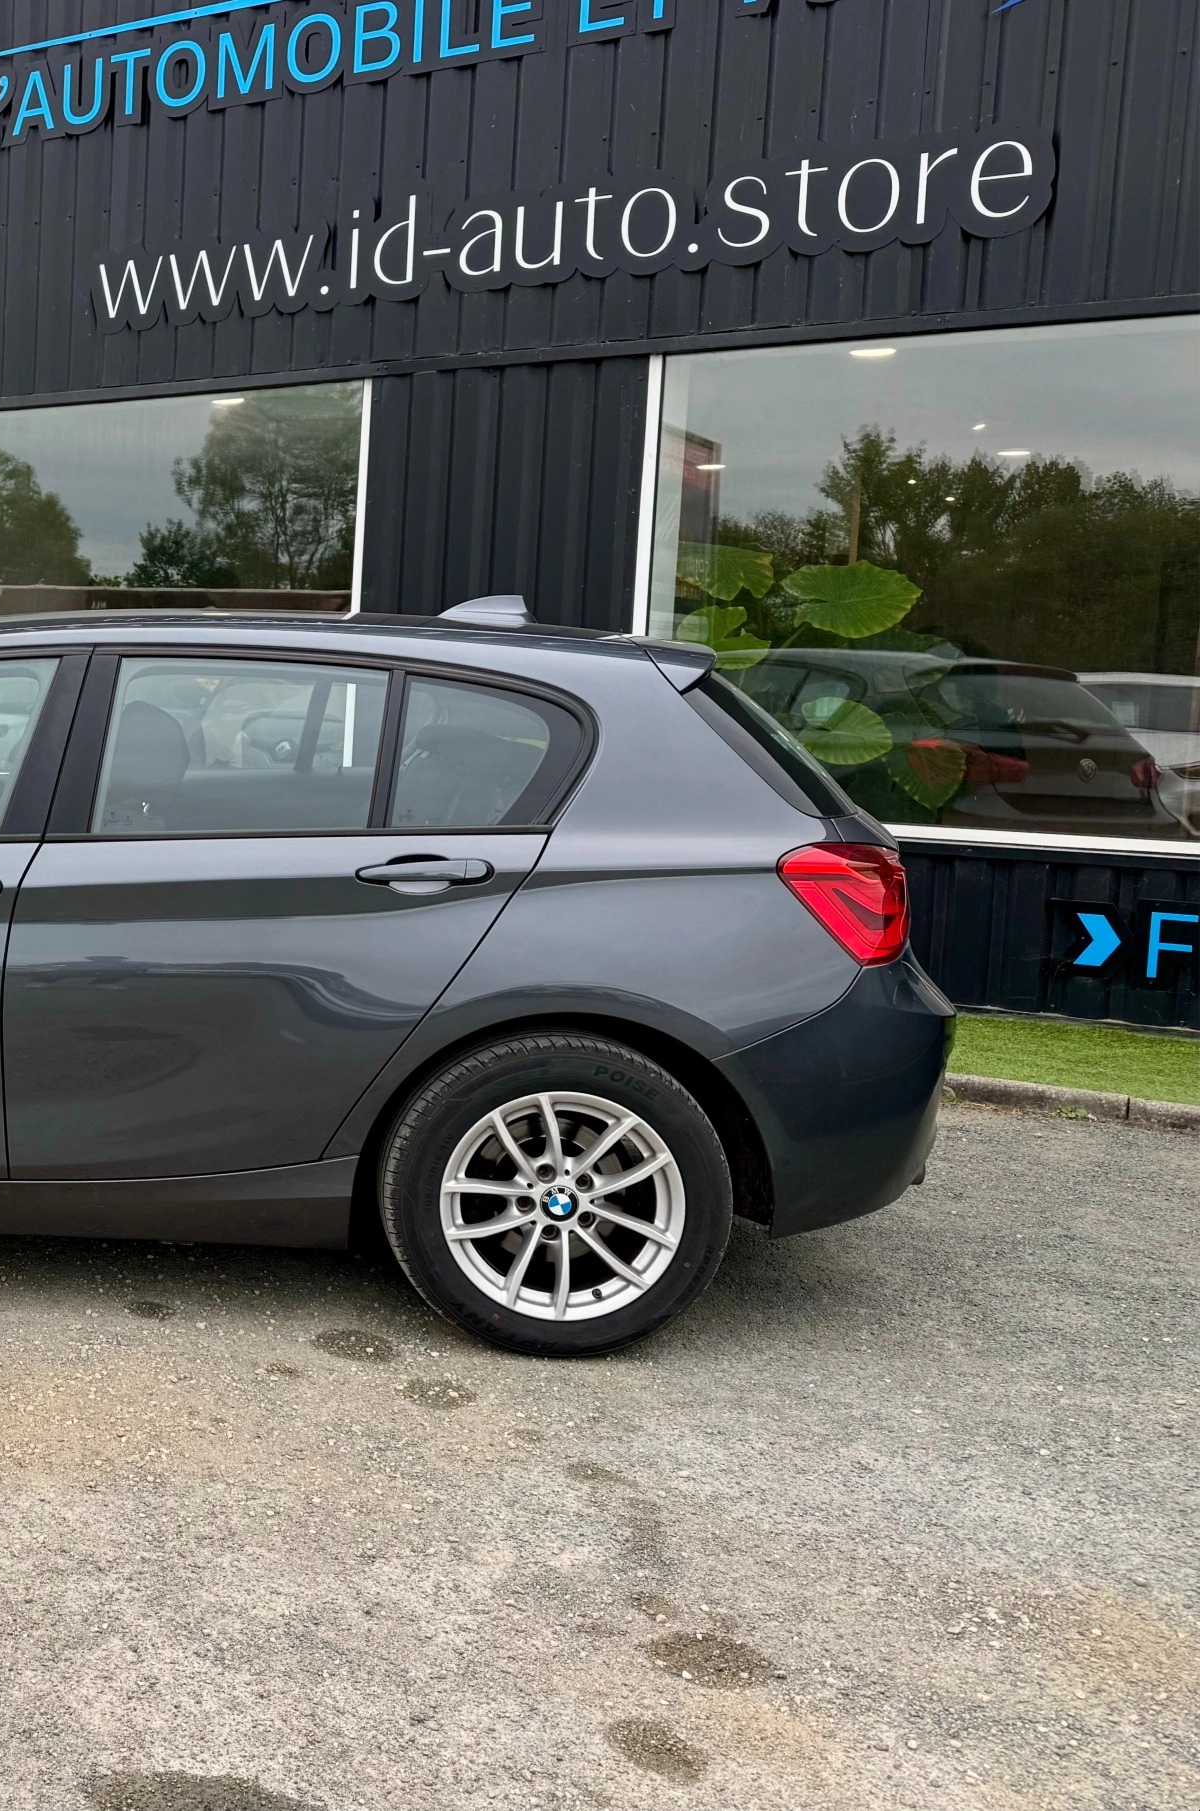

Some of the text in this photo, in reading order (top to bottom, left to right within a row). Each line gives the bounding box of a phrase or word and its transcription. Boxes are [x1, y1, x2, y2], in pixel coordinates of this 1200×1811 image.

[99, 140, 1033, 319] www.id-auto.store
[1146, 911, 1199, 978] F
[593, 1065, 660, 1100] POISE
